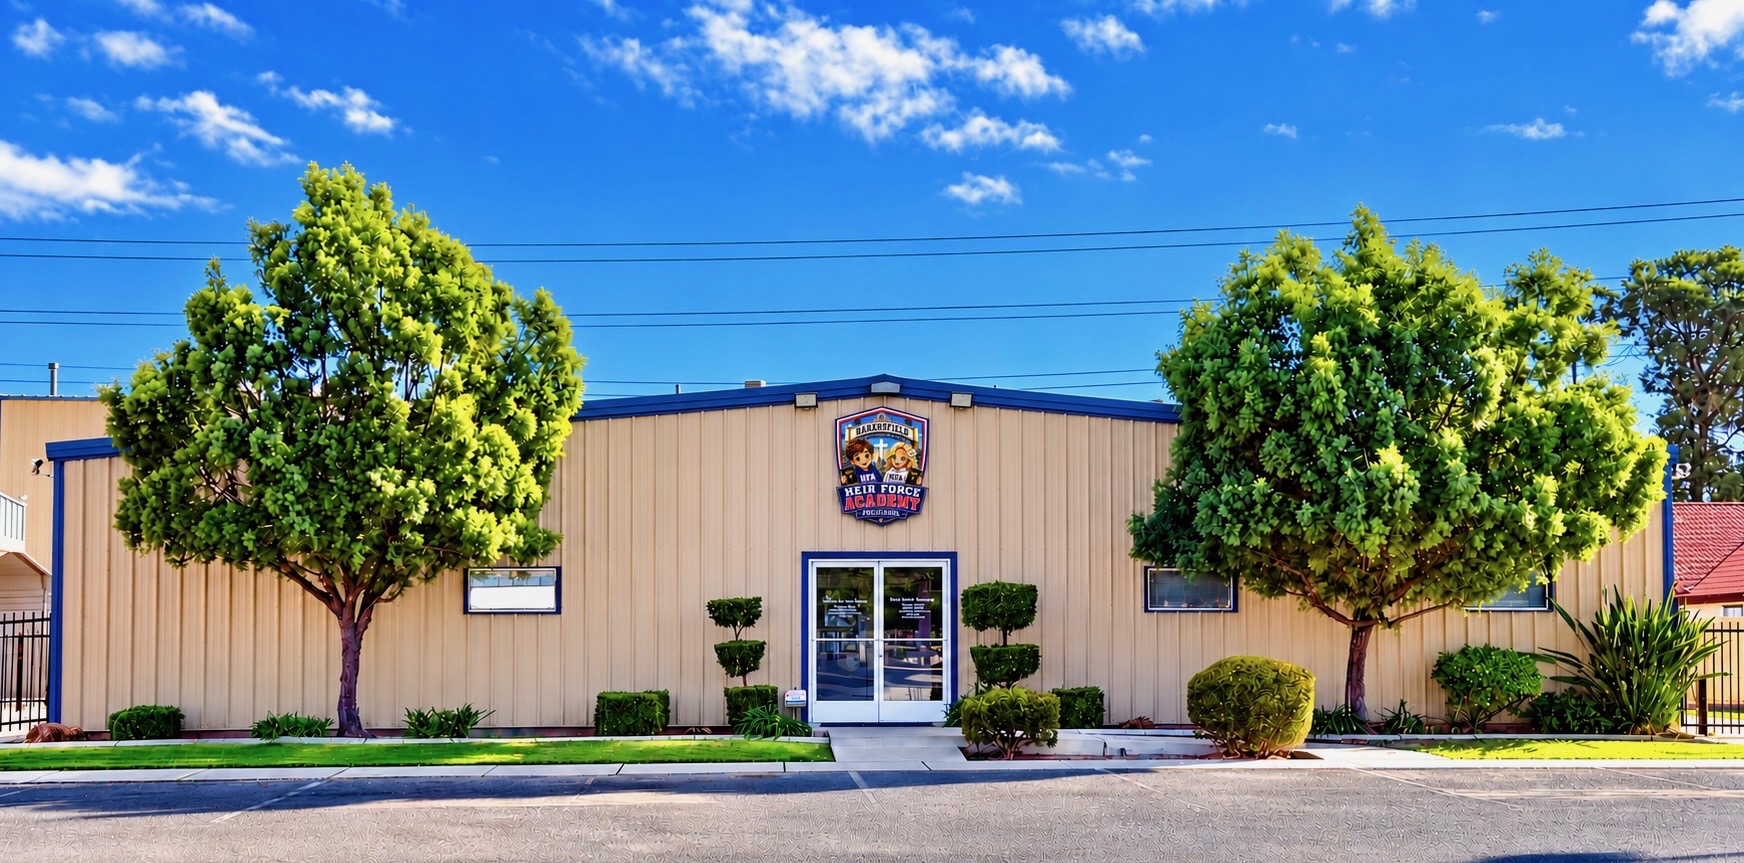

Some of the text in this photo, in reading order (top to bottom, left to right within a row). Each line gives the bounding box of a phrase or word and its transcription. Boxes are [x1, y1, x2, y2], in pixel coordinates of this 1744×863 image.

[844, 485, 922, 497] HEIR FORCE
[844, 494, 921, 511] ACADEMY
